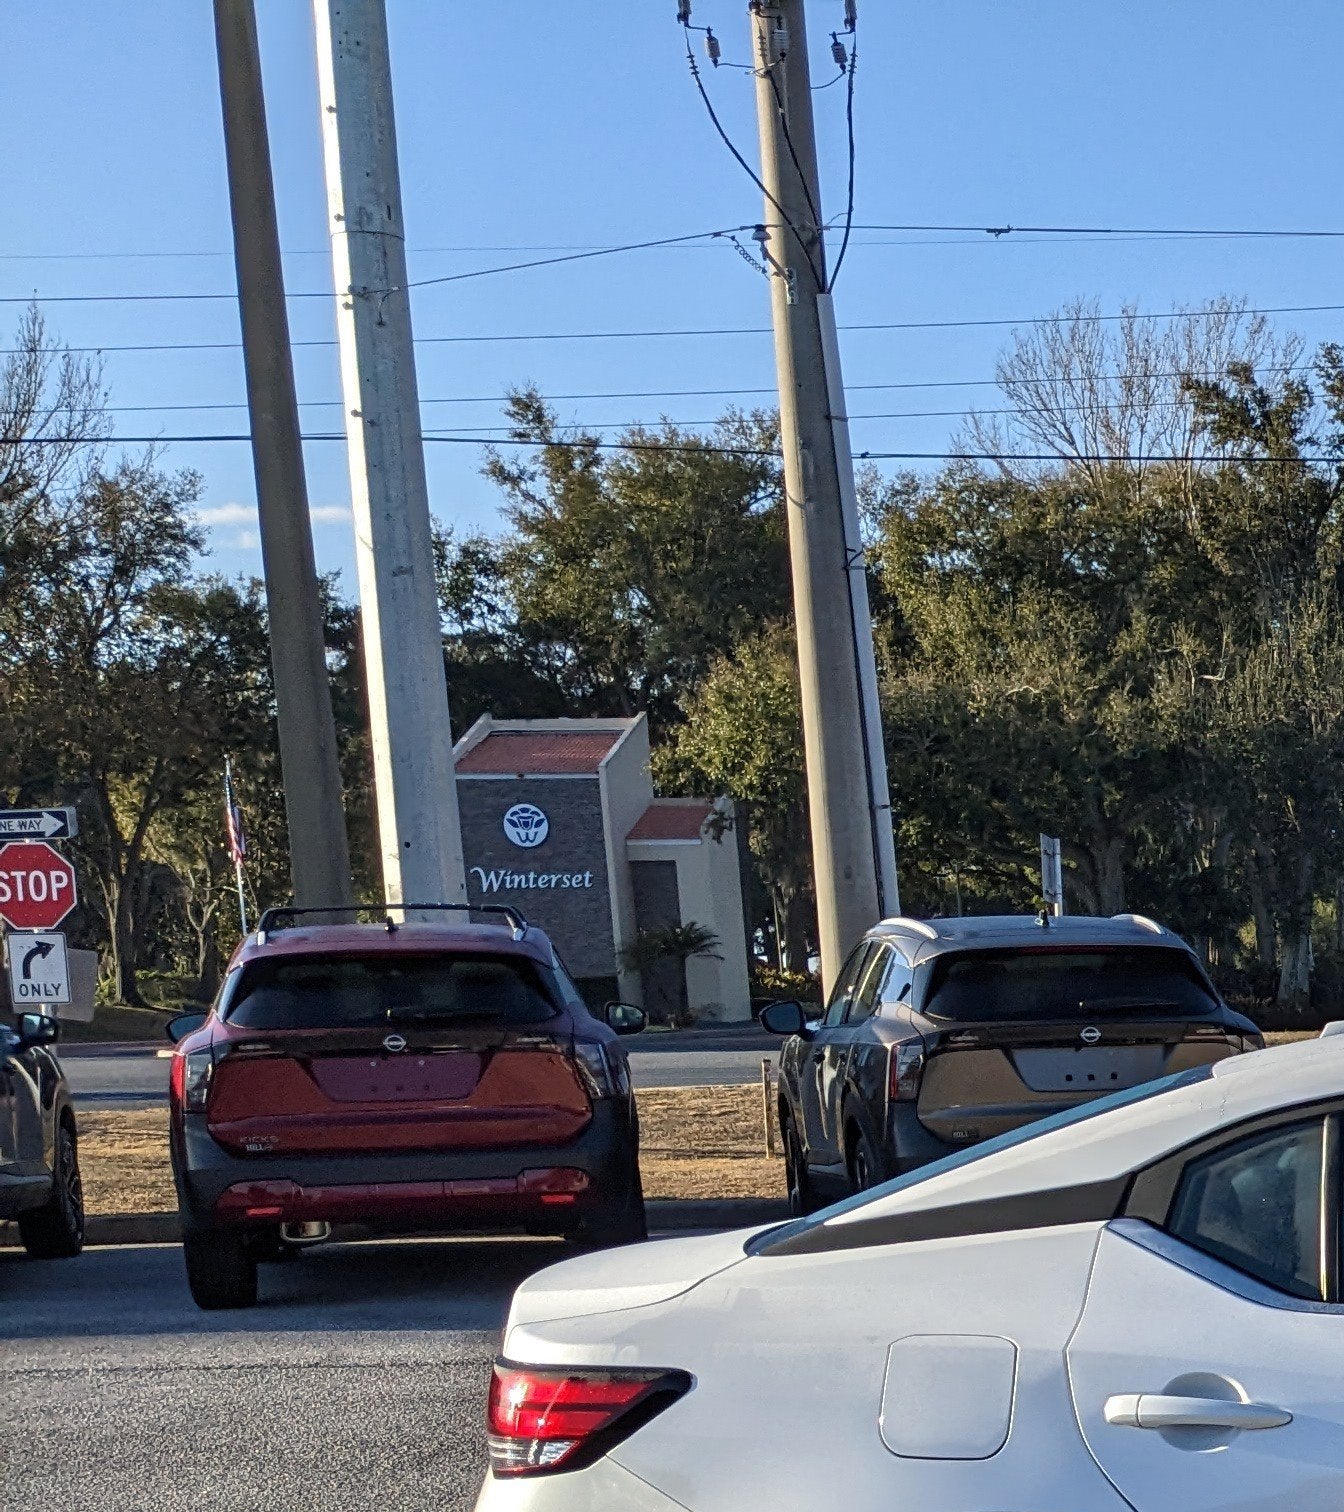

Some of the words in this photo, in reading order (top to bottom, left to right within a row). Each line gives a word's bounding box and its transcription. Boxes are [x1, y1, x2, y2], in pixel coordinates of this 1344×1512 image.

[0, 821, 14, 831] NE
[17, 820, 42, 831] WAY
[0, 870, 68, 902] STOP
[470, 866, 593, 893] Winterset
[19, 983, 62, 997] ONLY
